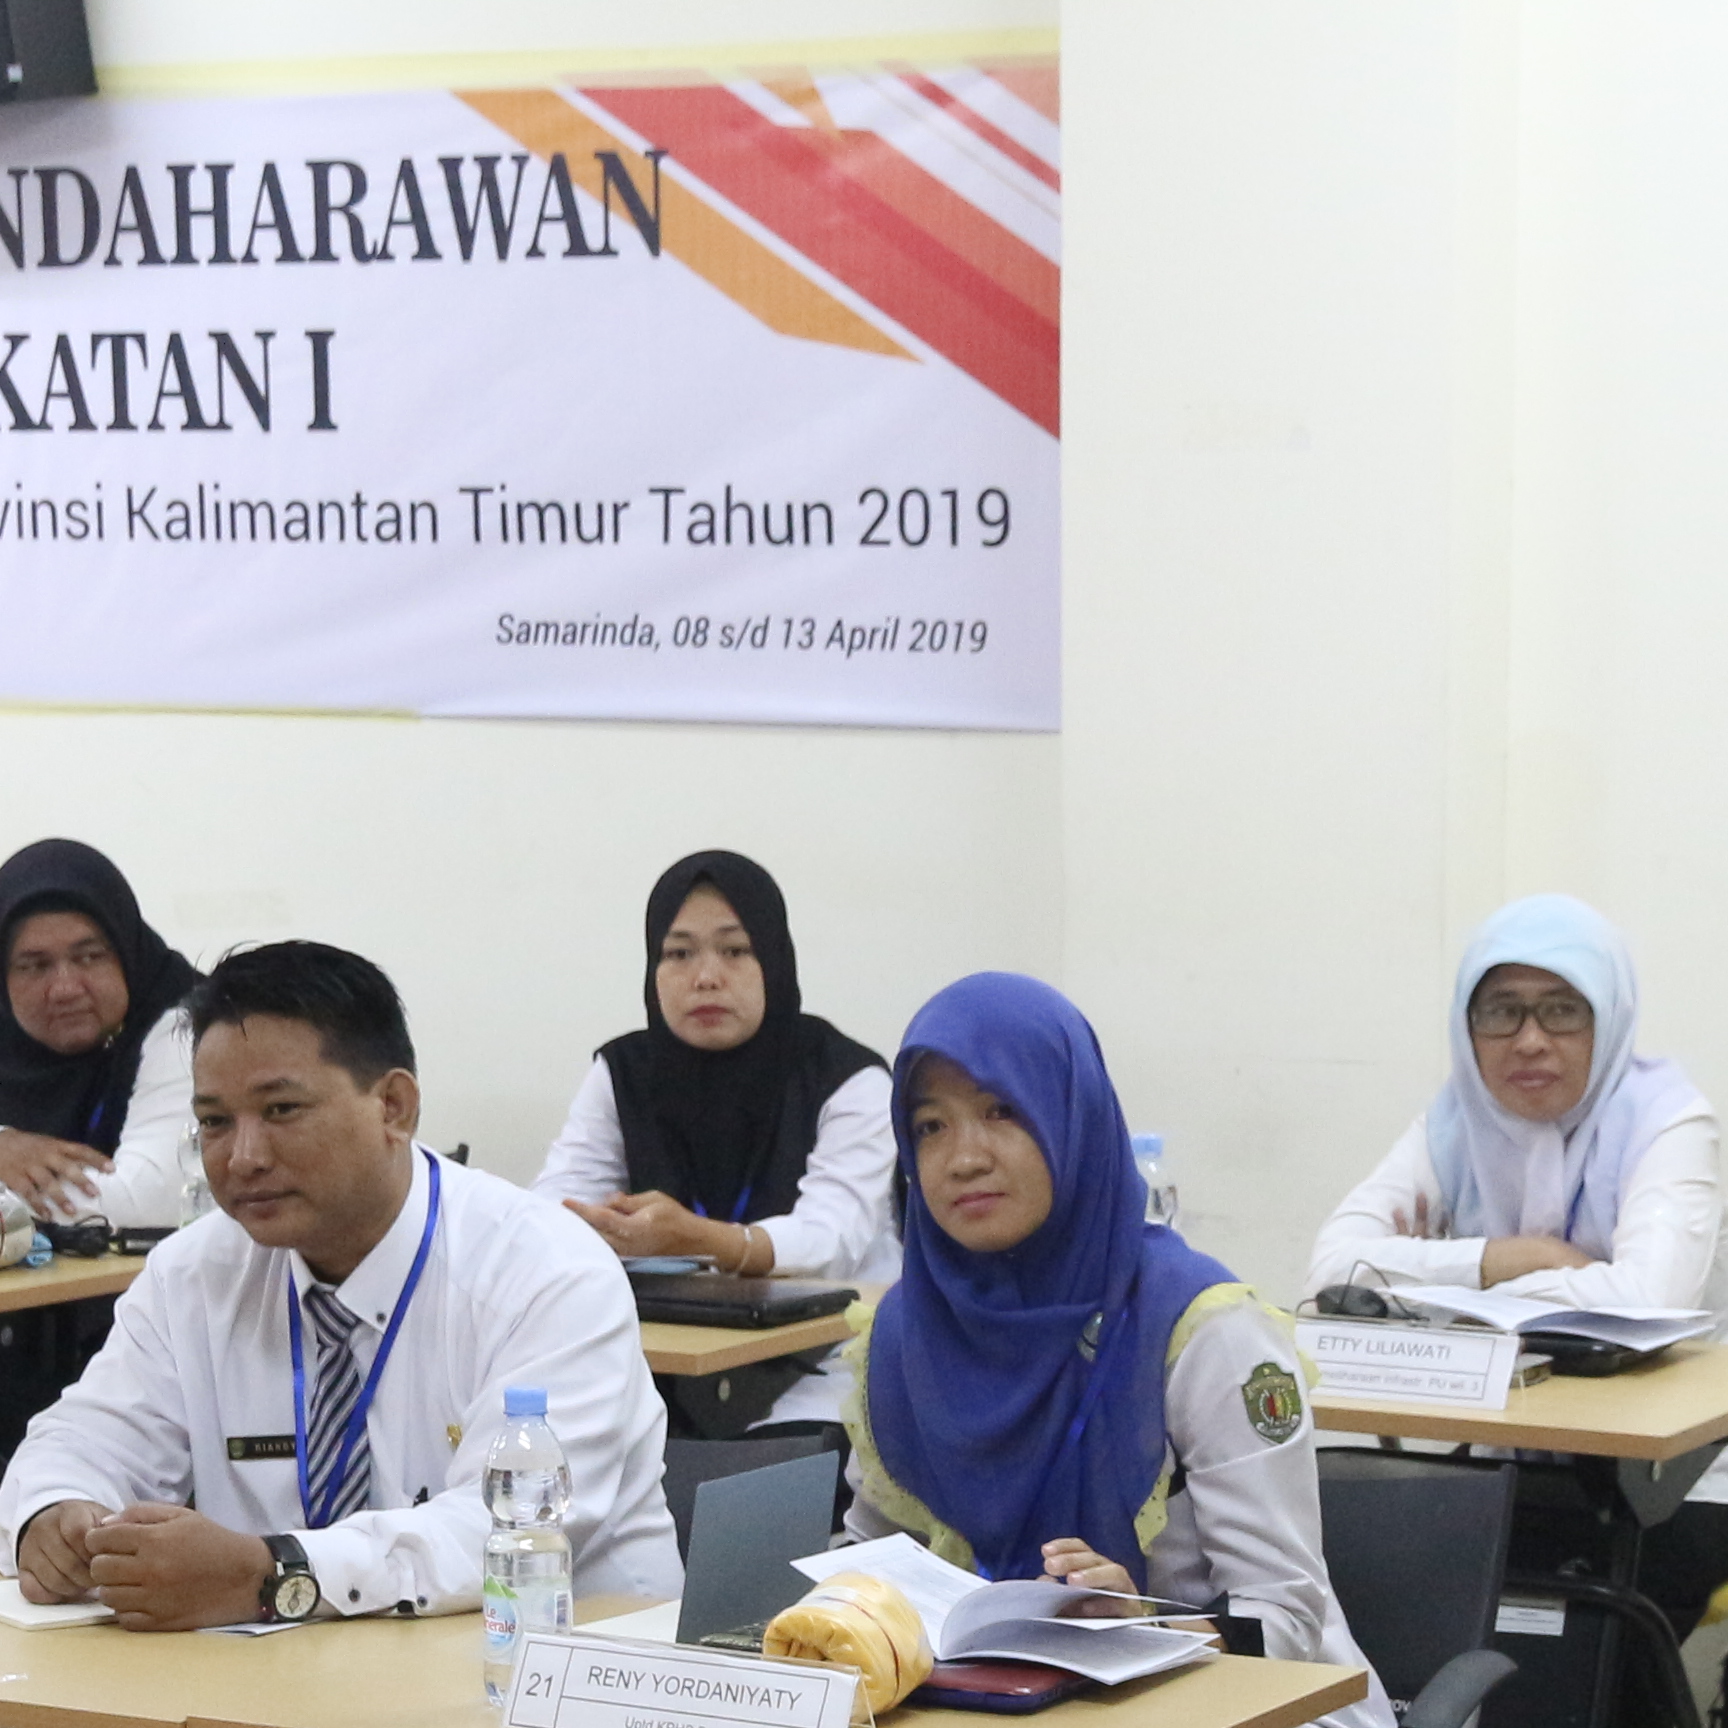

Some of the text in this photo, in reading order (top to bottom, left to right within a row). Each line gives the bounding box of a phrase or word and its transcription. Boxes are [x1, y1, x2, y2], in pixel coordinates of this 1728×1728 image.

[304, 329, 339, 432] I
[126, 482, 439, 545] Kalimantan
[458, 483, 631, 546] Timur
[648, 484, 834, 548] Tahun
[858, 486, 1012, 549] 2019
[495, 612, 988, 659] Samarinda, 08 s/d 13 April 2019
[1316, 1334, 1452, 1361] ETTY LILIAWATI
[525, 1671, 554, 1699] 21
[587, 1664, 803, 1711] RENY YORDANIYATY
